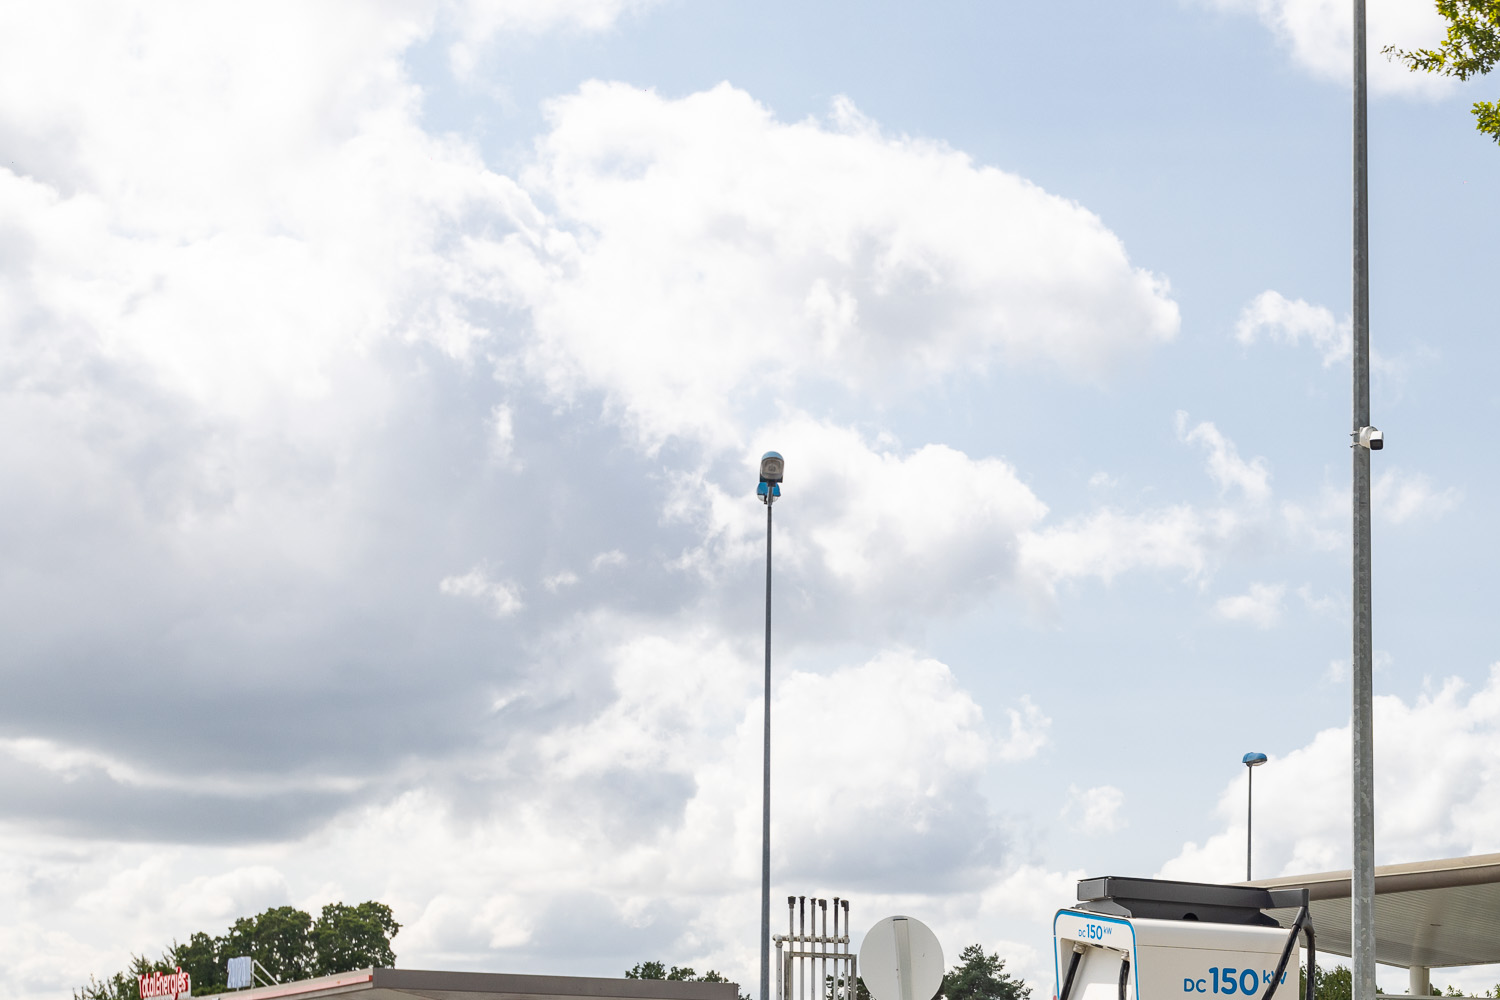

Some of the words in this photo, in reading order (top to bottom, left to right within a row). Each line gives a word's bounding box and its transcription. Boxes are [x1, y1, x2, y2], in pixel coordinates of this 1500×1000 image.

[1078, 928, 1087, 938] DC
[1086, 923, 1103, 941] 150
[1103, 926, 1113, 936] kW
[138, 966, 190, 1000] TotalEnergies
[1183, 978, 1207, 994] DC
[1208, 966, 1260, 996] 150
